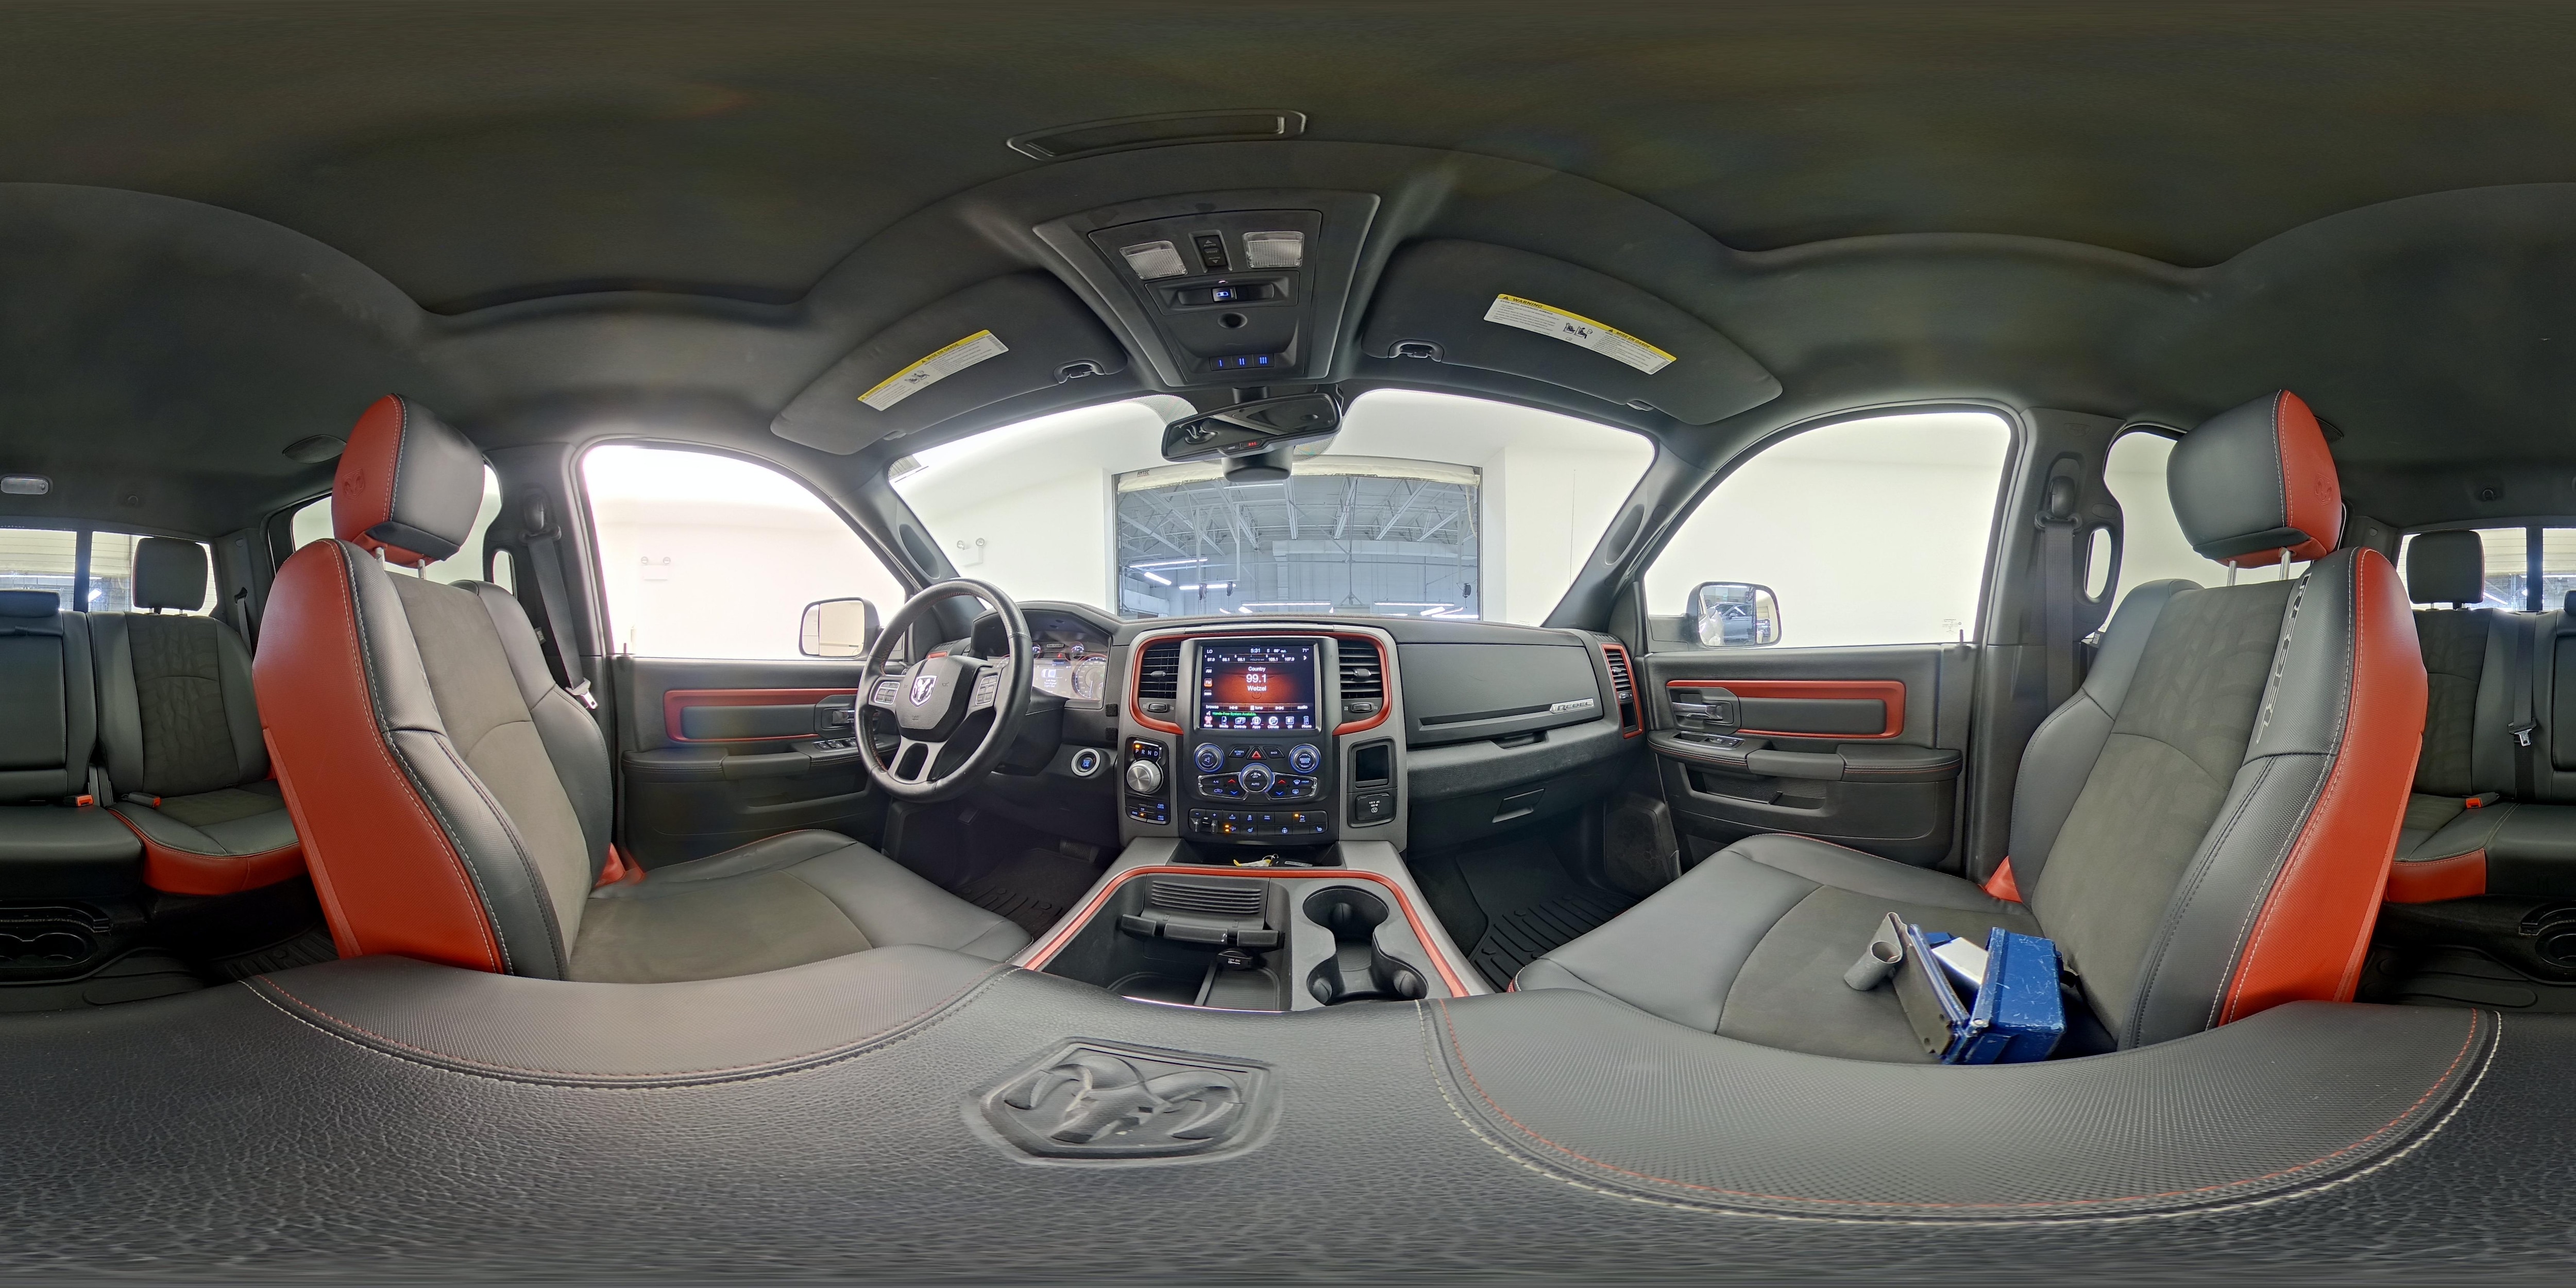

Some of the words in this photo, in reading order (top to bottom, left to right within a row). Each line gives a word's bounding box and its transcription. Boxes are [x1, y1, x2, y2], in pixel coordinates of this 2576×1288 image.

[1513, 298, 1543, 308] WARNING
[943, 343, 958, 351] GARDE
[1635, 340, 1651, 348] GARDE
[1246, 674, 1266, 683] 99.1
[1557, 701, 1591, 711] REBEL
